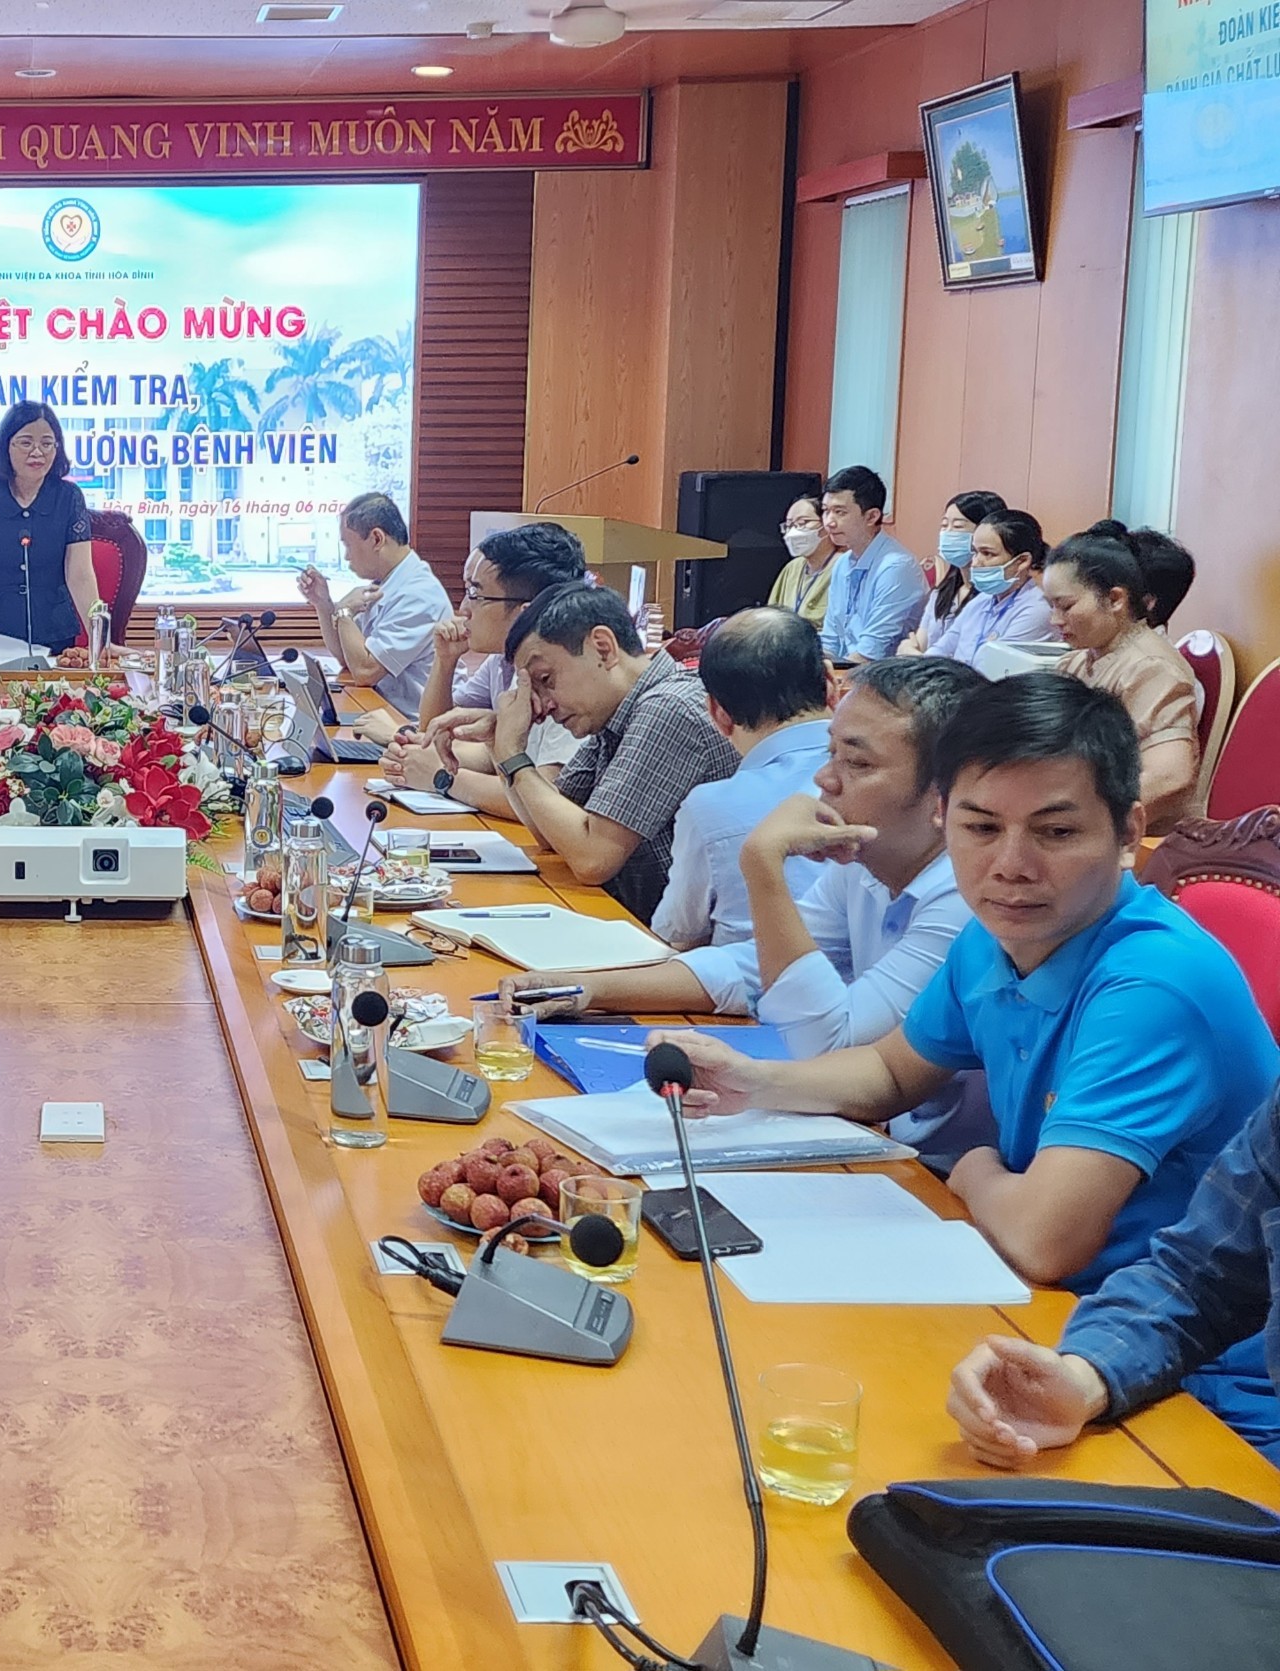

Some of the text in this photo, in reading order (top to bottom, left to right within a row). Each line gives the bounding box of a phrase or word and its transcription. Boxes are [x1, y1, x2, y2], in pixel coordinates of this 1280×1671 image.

[20, 122, 172, 169] QUANG
[185, 121, 294, 158] VINH
[308, 106, 436, 156] MUÔN
[448, 106, 545, 153] NĂM
[55, 271, 81, 280] KHOA
[46, 297, 168, 340] CHÀO
[183, 296, 307, 339] MỪNG
[41, 361, 117, 406] KIỂM
[130, 374, 198, 411] TRA,
[75, 430, 158, 473] ƯỢNG
[173, 427, 254, 473] BỆNH
[267, 425, 338, 472] VIỆN
[138, 501, 173, 516] Bình,
[179, 501, 218, 517] ngày
[225, 501, 241, 513] 16
[246, 500, 291, 516] tháng
[295, 501, 314, 513] 06
